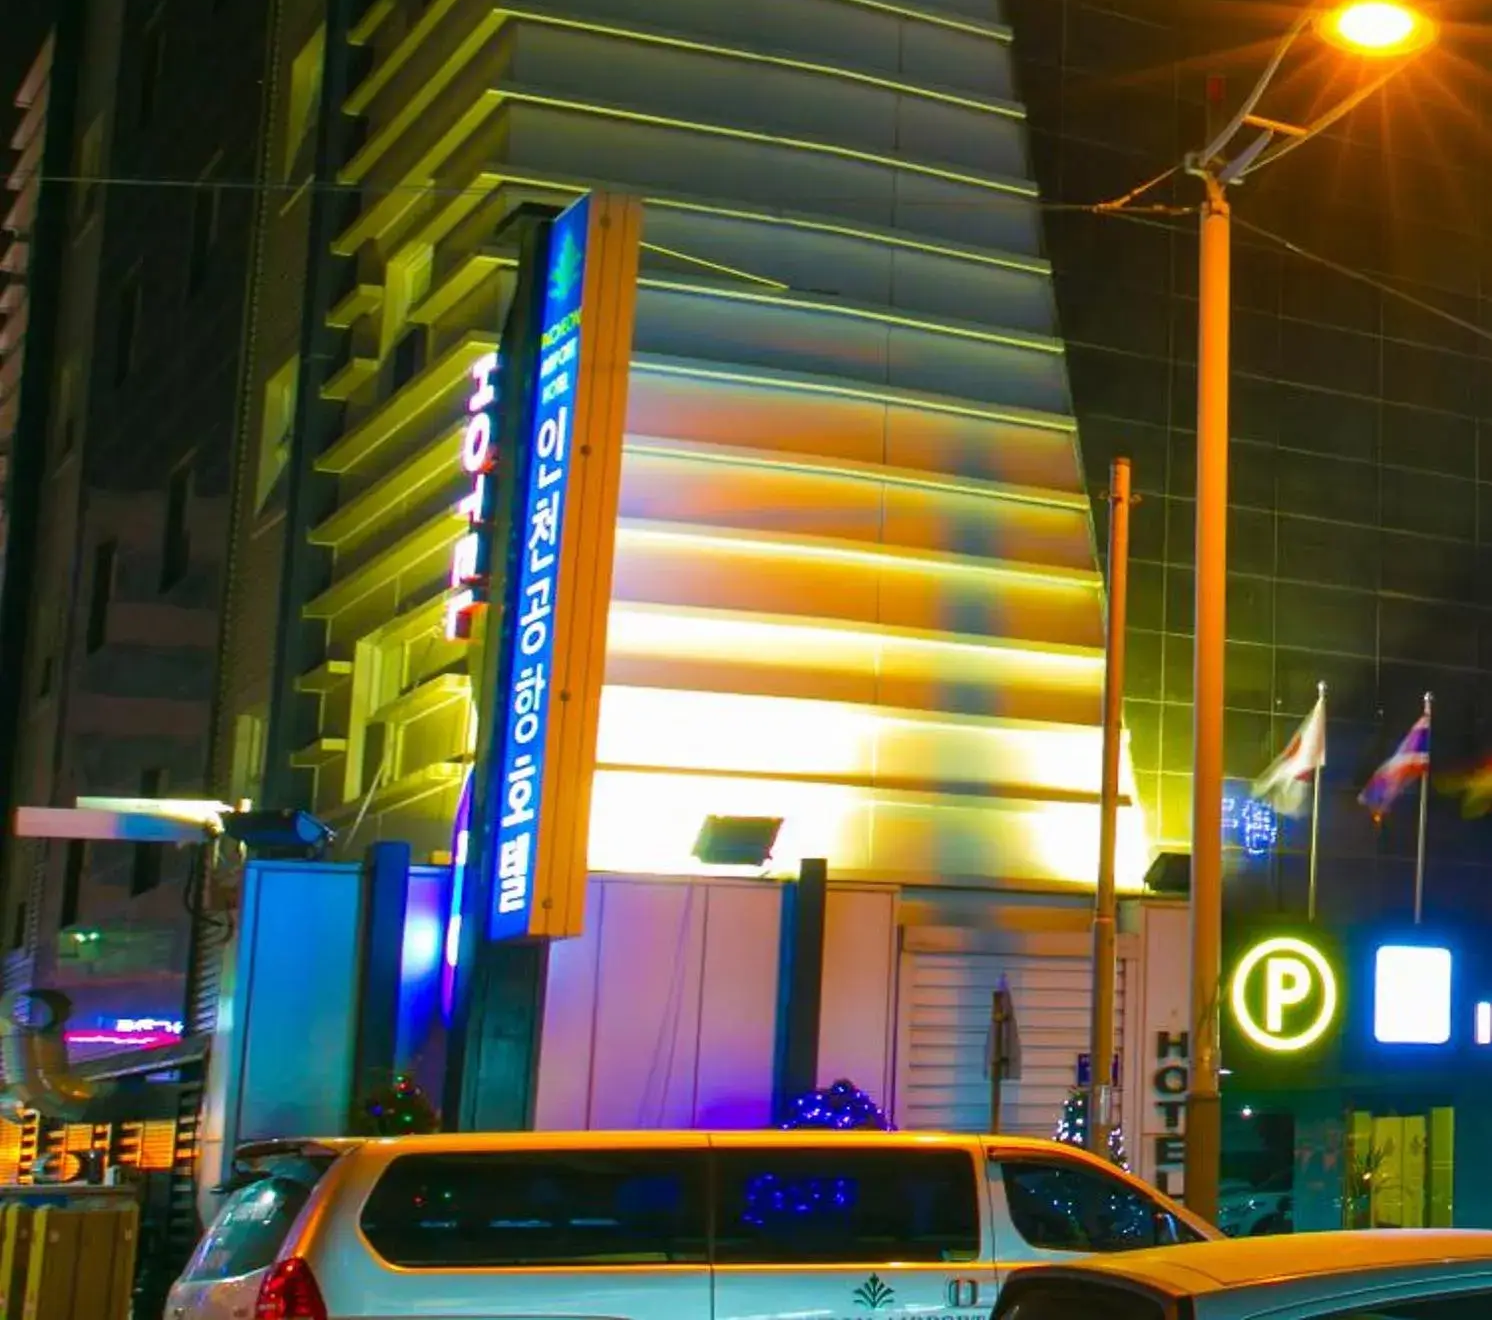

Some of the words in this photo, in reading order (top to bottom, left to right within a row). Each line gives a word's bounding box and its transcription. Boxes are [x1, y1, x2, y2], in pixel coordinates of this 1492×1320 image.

[446, 351, 498, 641] HOTEL
[1266, 957, 1311, 1032] P
[1154, 1031, 1188, 1203] HOTEL
